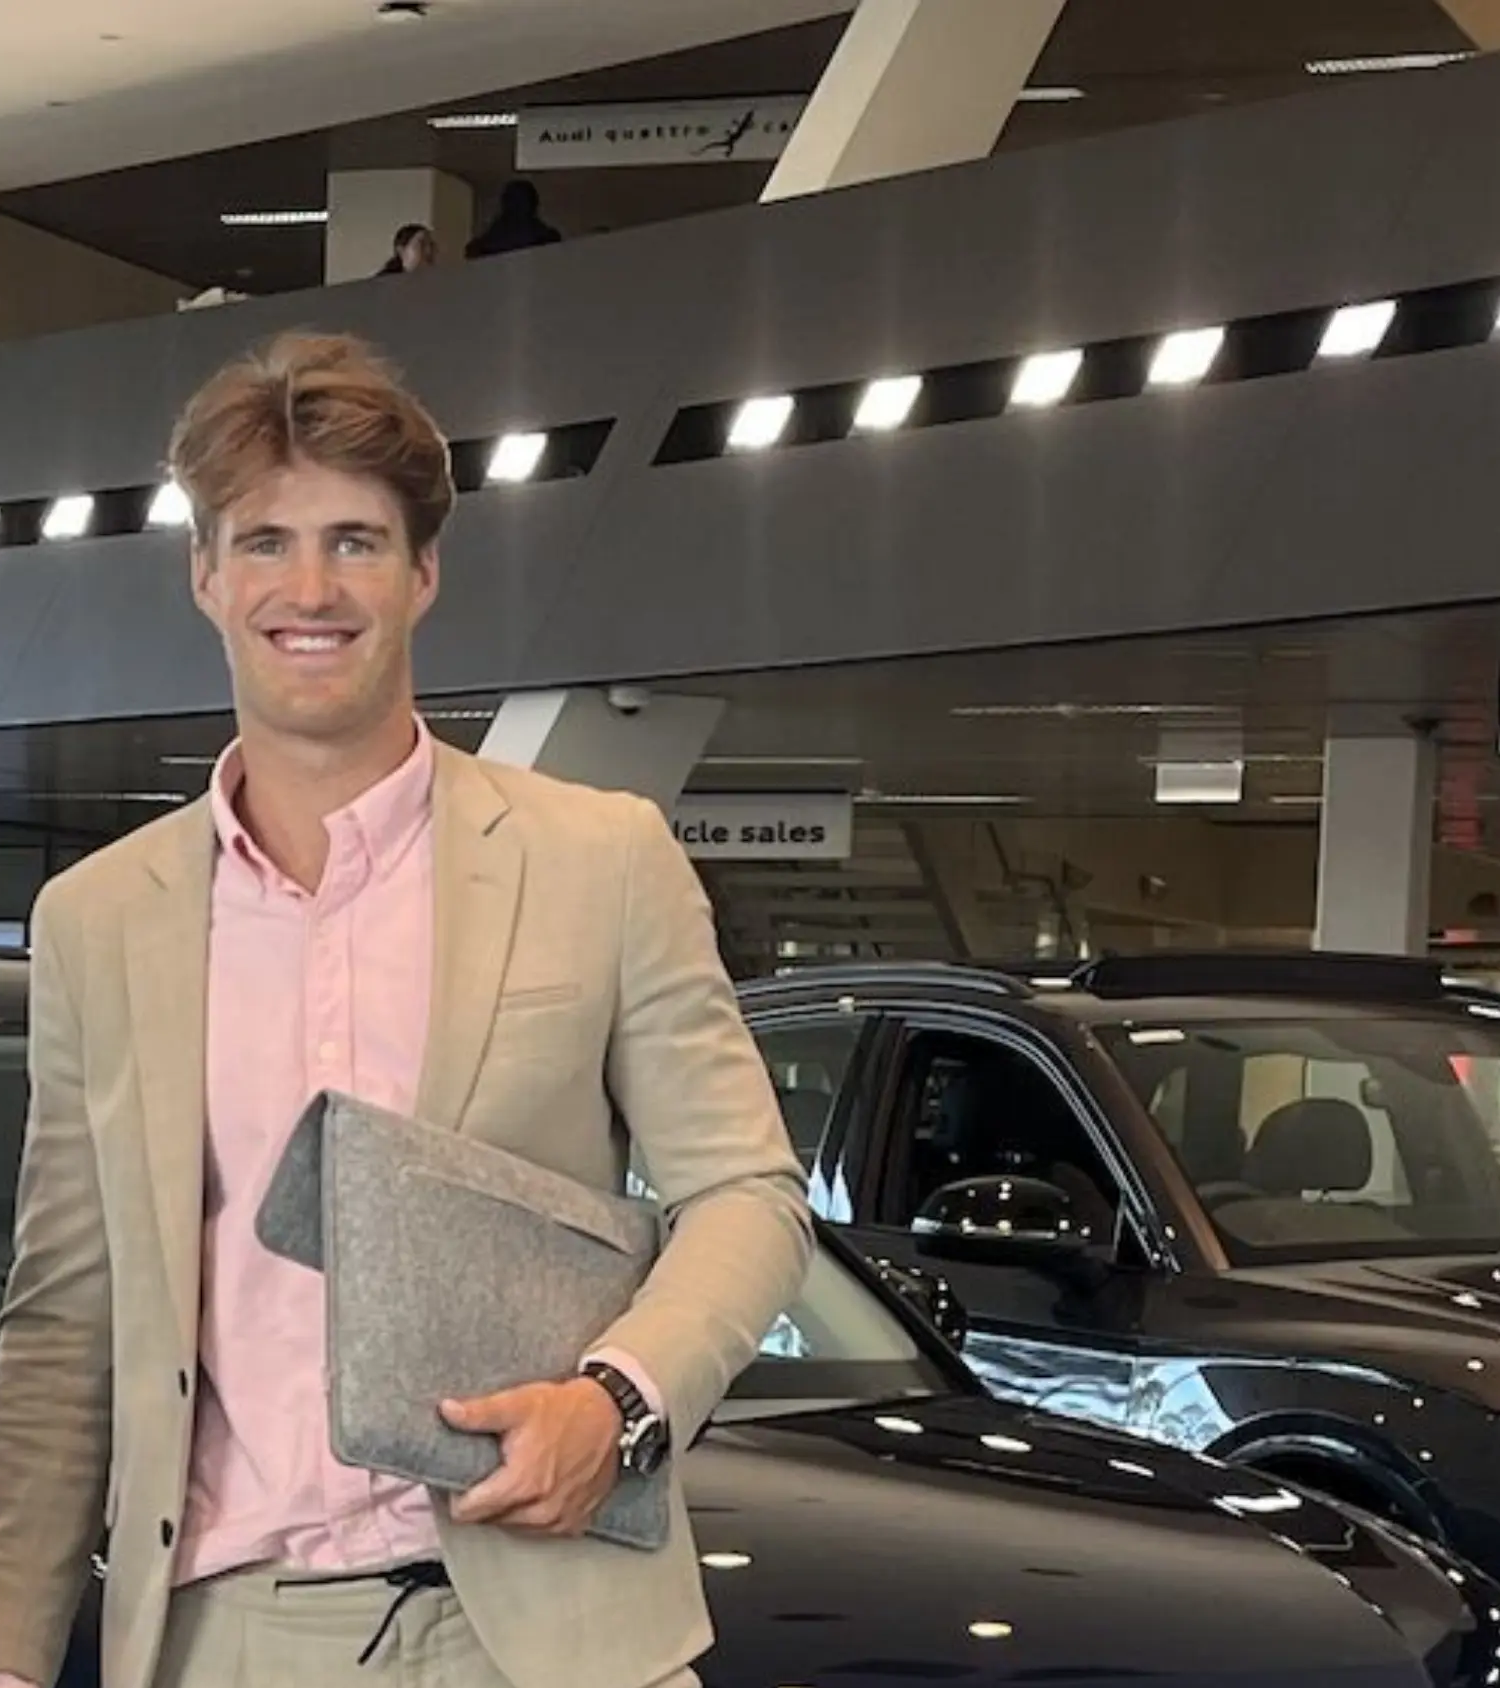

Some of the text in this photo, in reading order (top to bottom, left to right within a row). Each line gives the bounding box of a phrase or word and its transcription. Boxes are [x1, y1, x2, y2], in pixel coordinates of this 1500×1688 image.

[539, 126, 592, 144] Audi
[604, 124, 711, 145] quattro
[673, 819, 826, 845] icle sales
